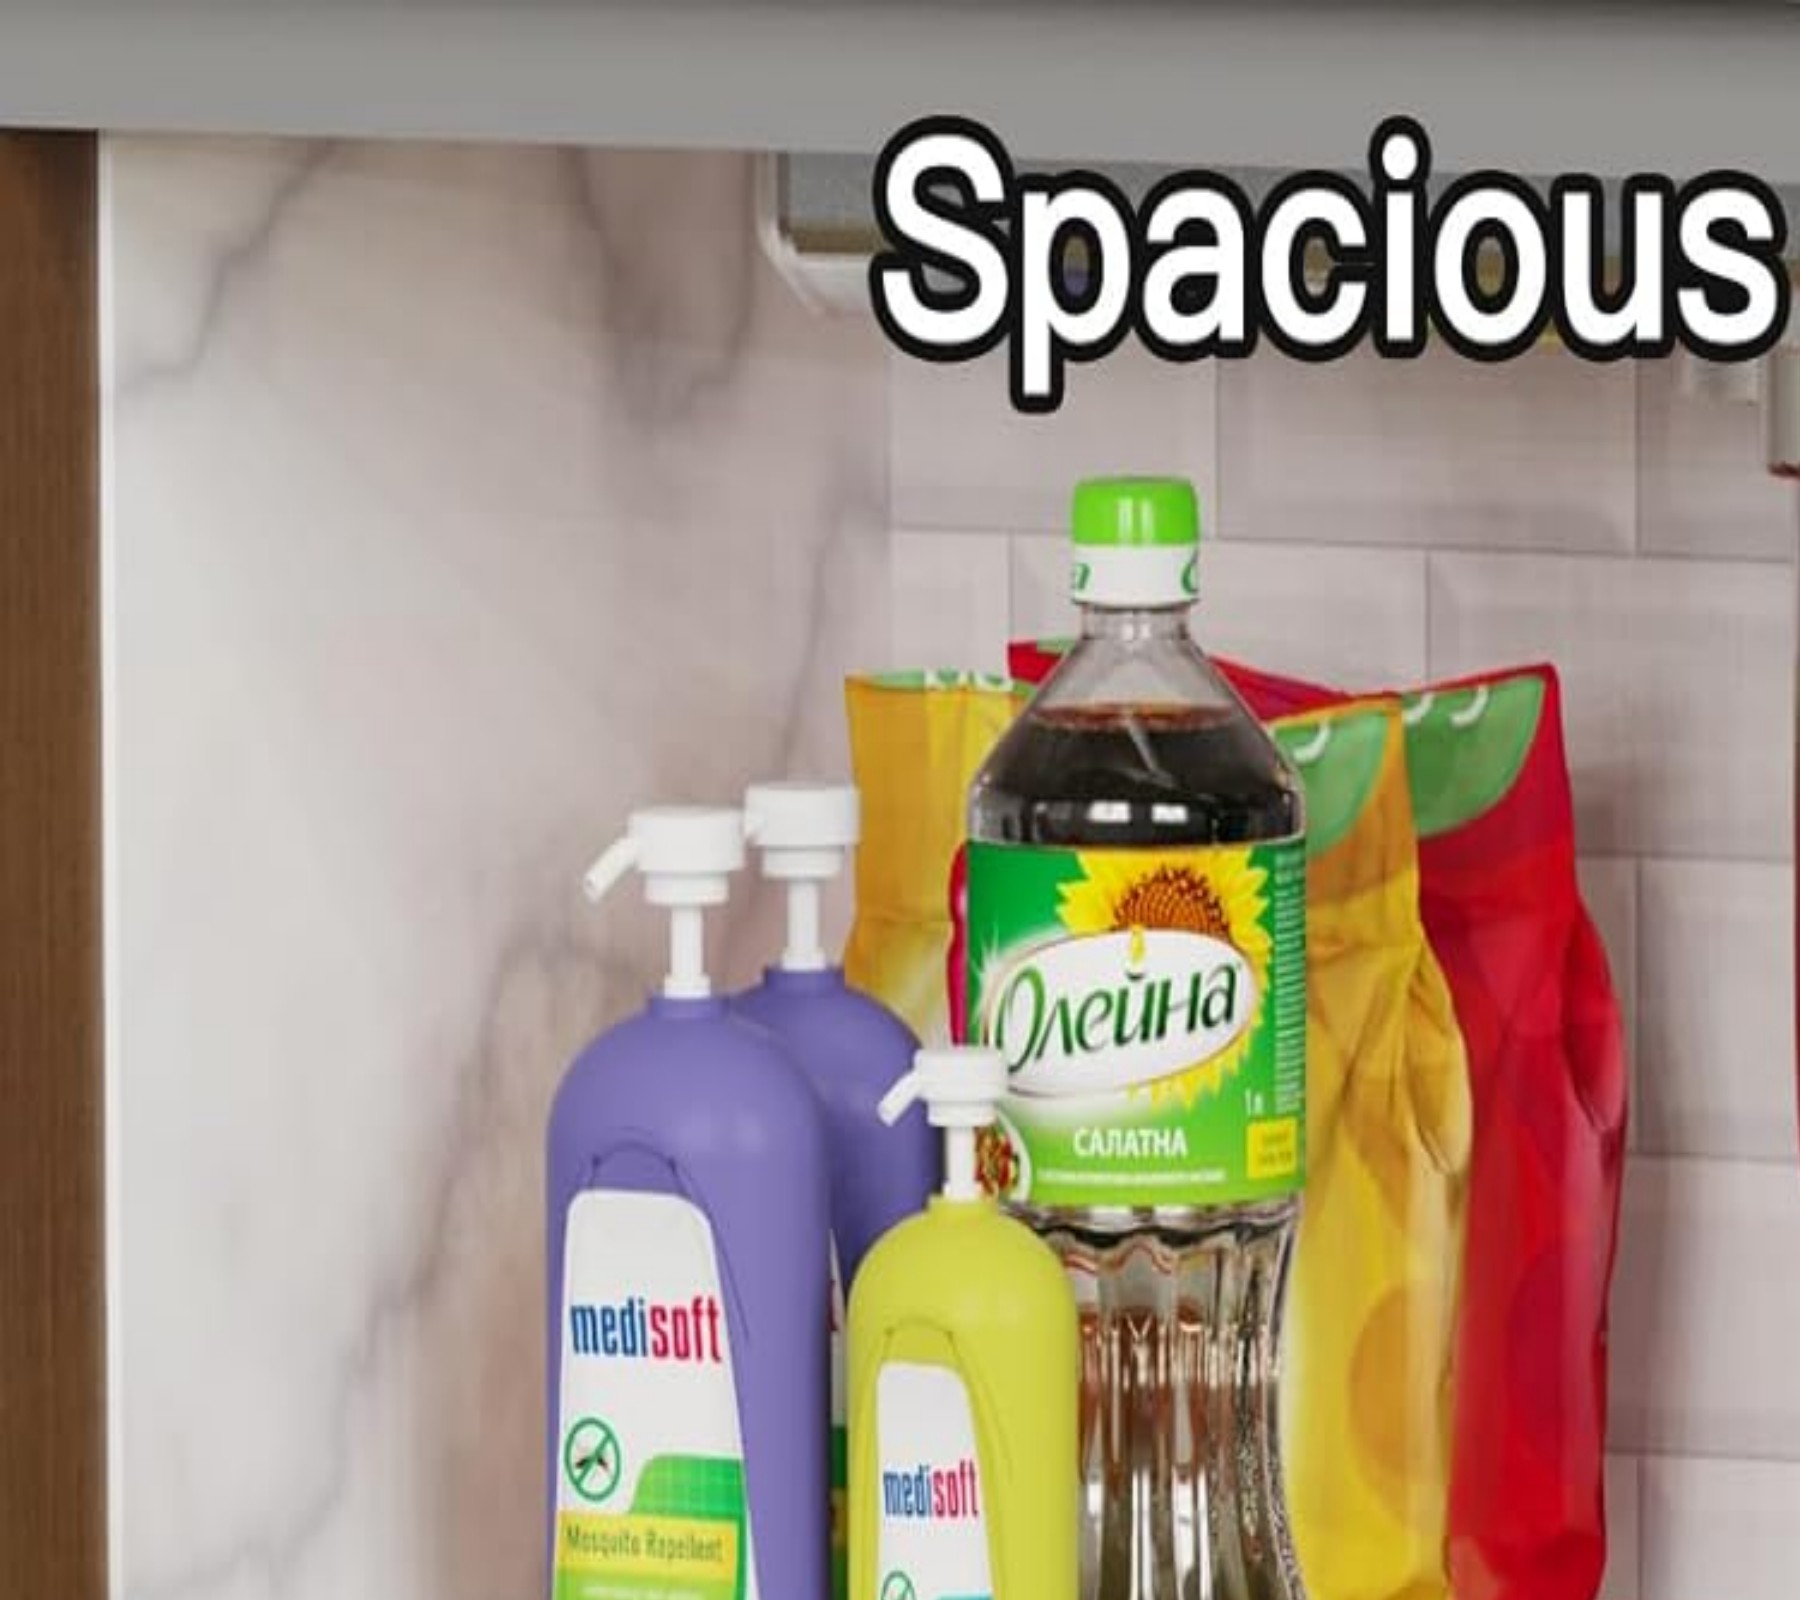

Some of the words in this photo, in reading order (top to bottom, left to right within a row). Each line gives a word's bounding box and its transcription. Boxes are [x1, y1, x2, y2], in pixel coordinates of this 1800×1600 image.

[995, 962, 1238, 1074] Олейна
[1072, 1128, 1189, 1158] САЛАТНА
[570, 1296, 723, 1363] medisoft
[883, 1459, 980, 1519] medisoft
